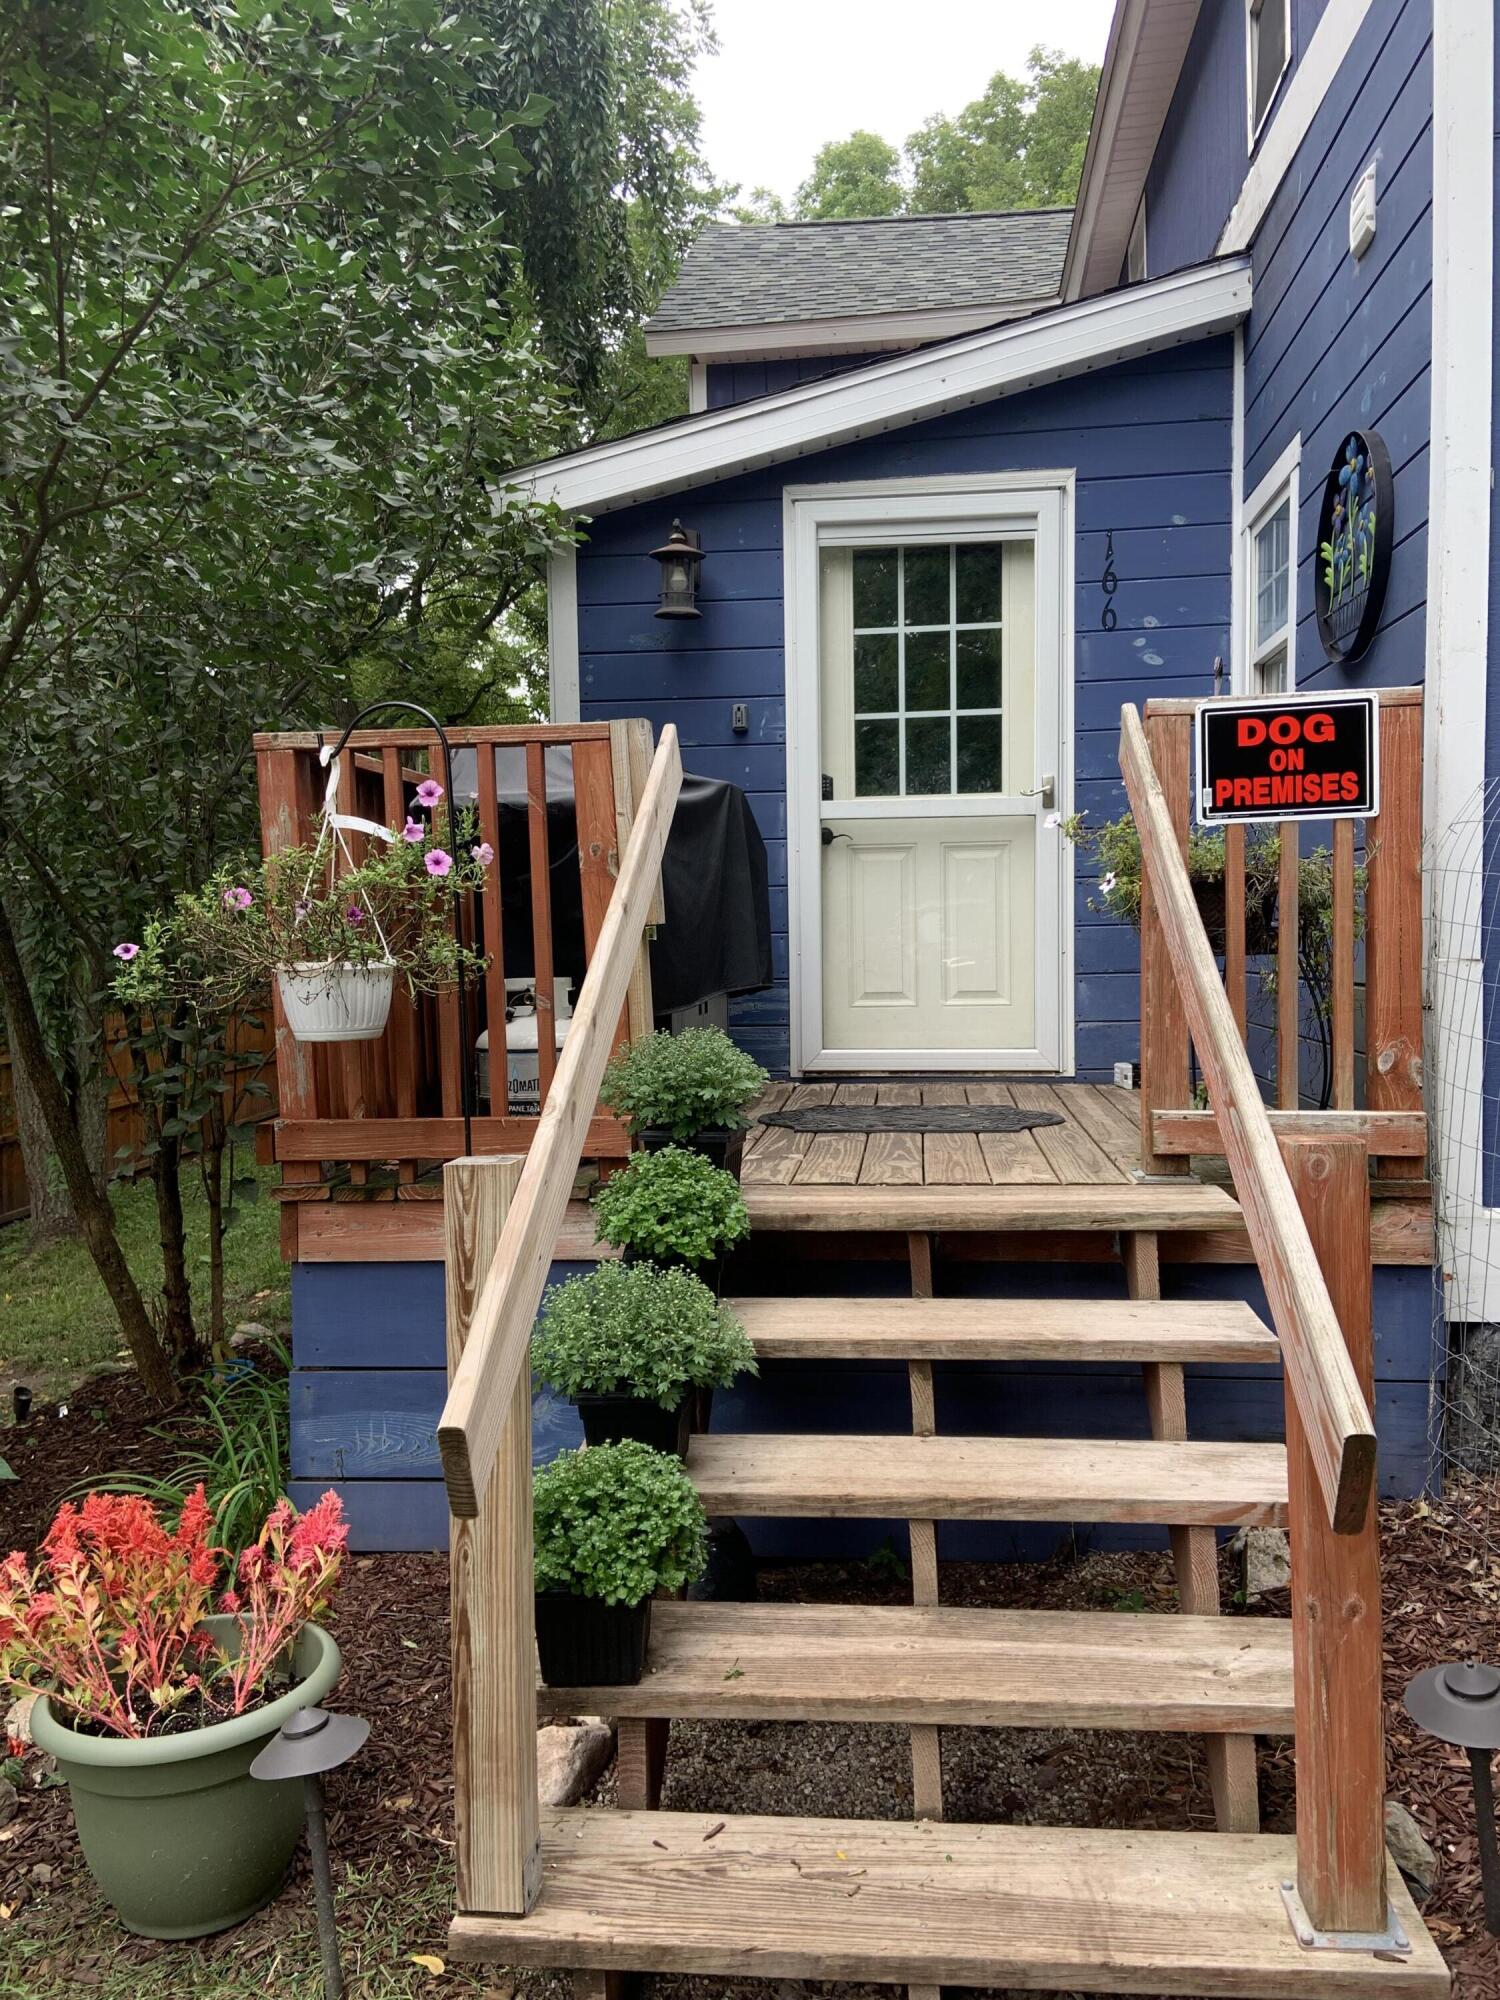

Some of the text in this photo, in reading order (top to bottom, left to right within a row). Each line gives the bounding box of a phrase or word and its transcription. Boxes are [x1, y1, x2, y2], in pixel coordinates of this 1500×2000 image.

[1237, 713, 1336, 747] DOG
[1269, 748, 1304, 772] ON
[1215, 771, 1360, 807] PREMISES
